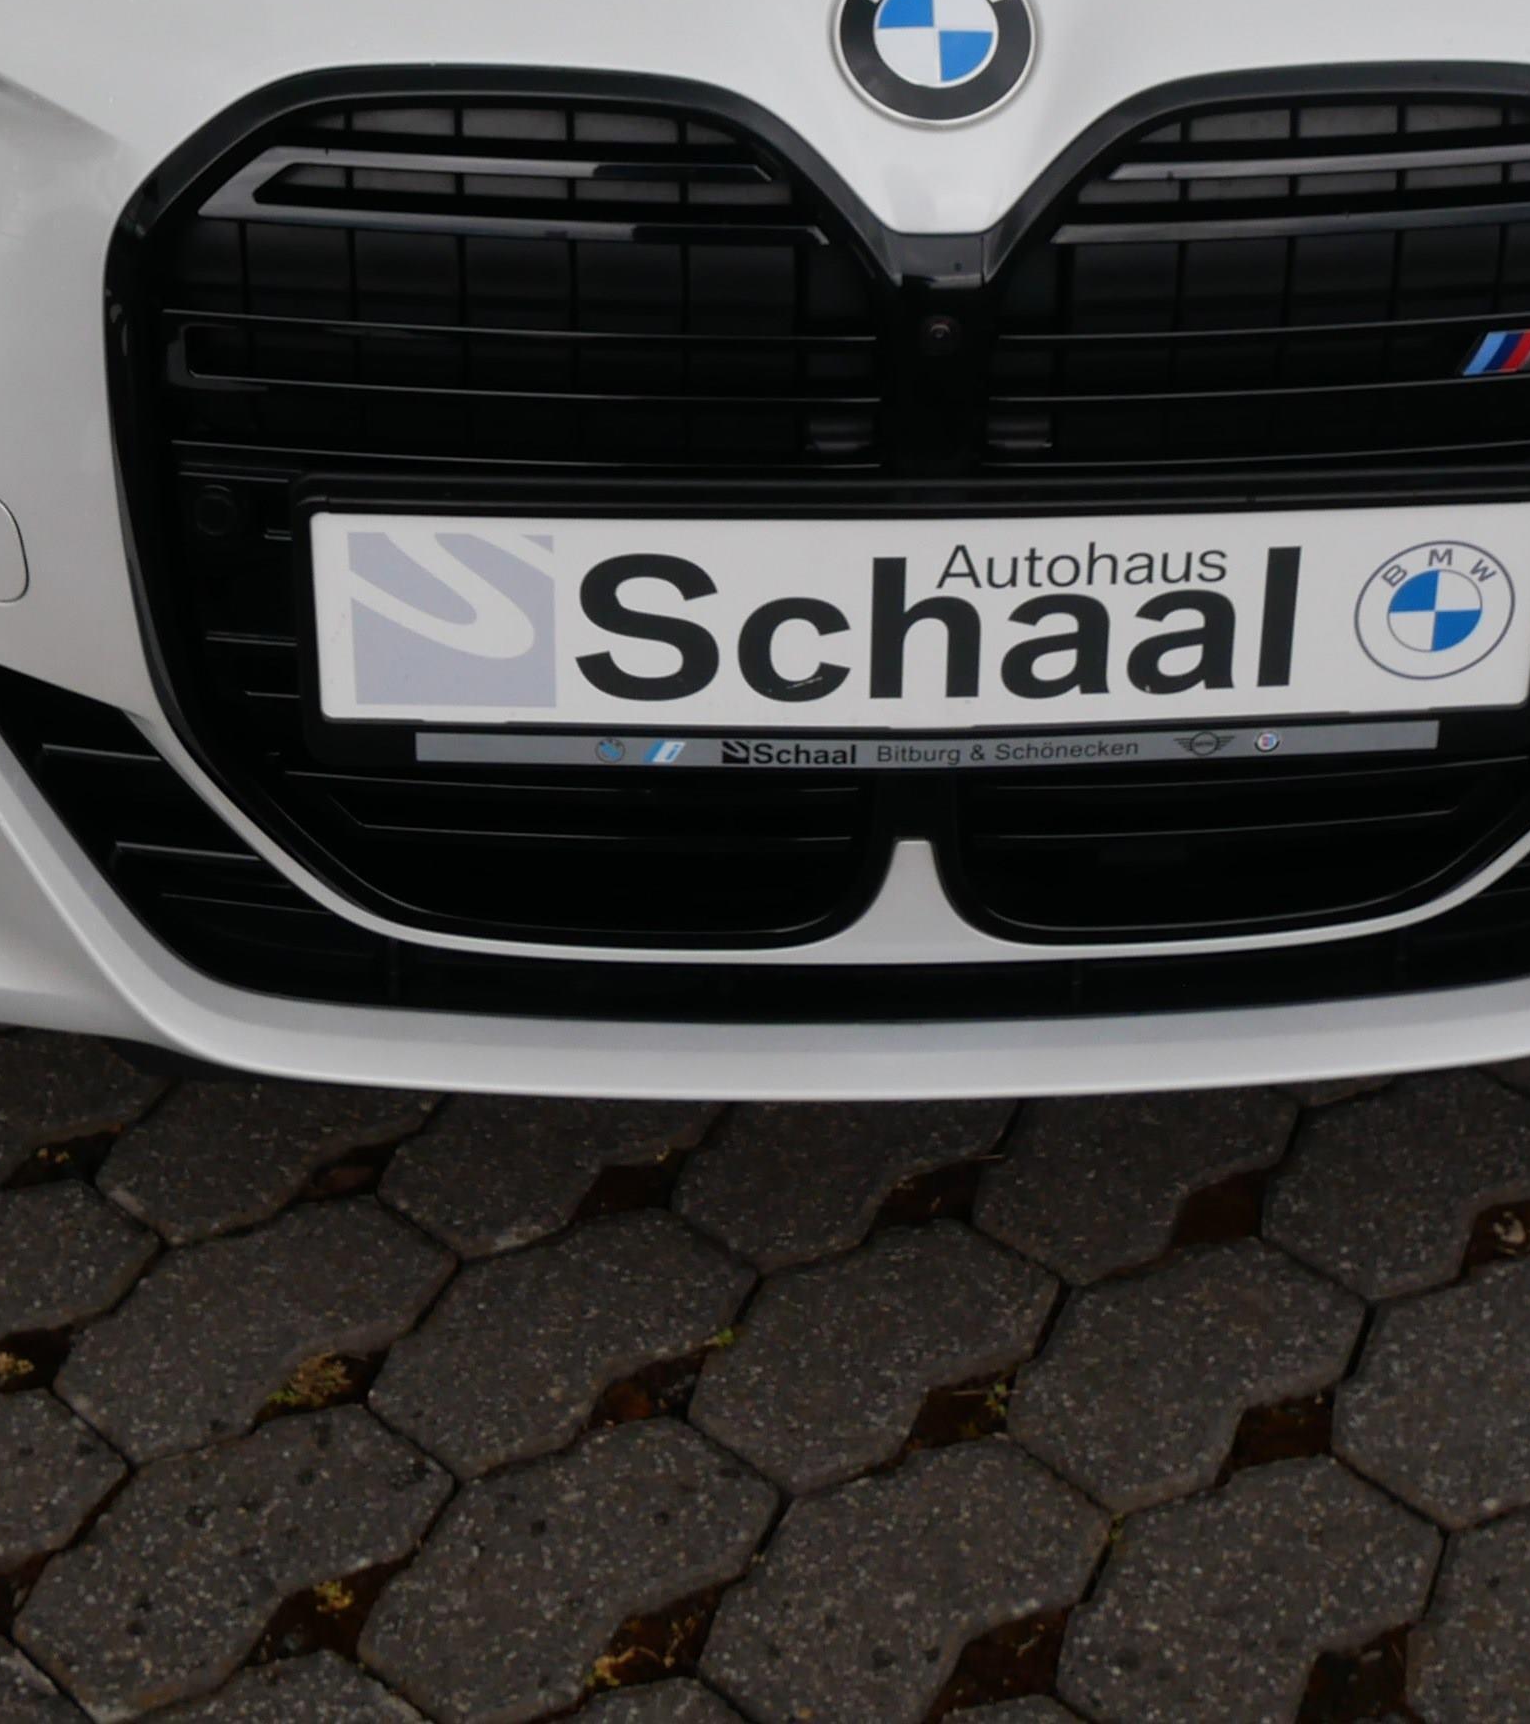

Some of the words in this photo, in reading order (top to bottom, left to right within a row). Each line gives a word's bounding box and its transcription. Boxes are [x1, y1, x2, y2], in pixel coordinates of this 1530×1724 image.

[936, 541, 1229, 590] Autohaus
[1381, 548, 1497, 588] BMW
[575, 545, 1302, 703] Schaal
[753, 743, 857, 765] Schaal
[877, 744, 961, 765] Bitburg
[970, 745, 986, 762] &
[995, 740, 1139, 761] Schönecken
